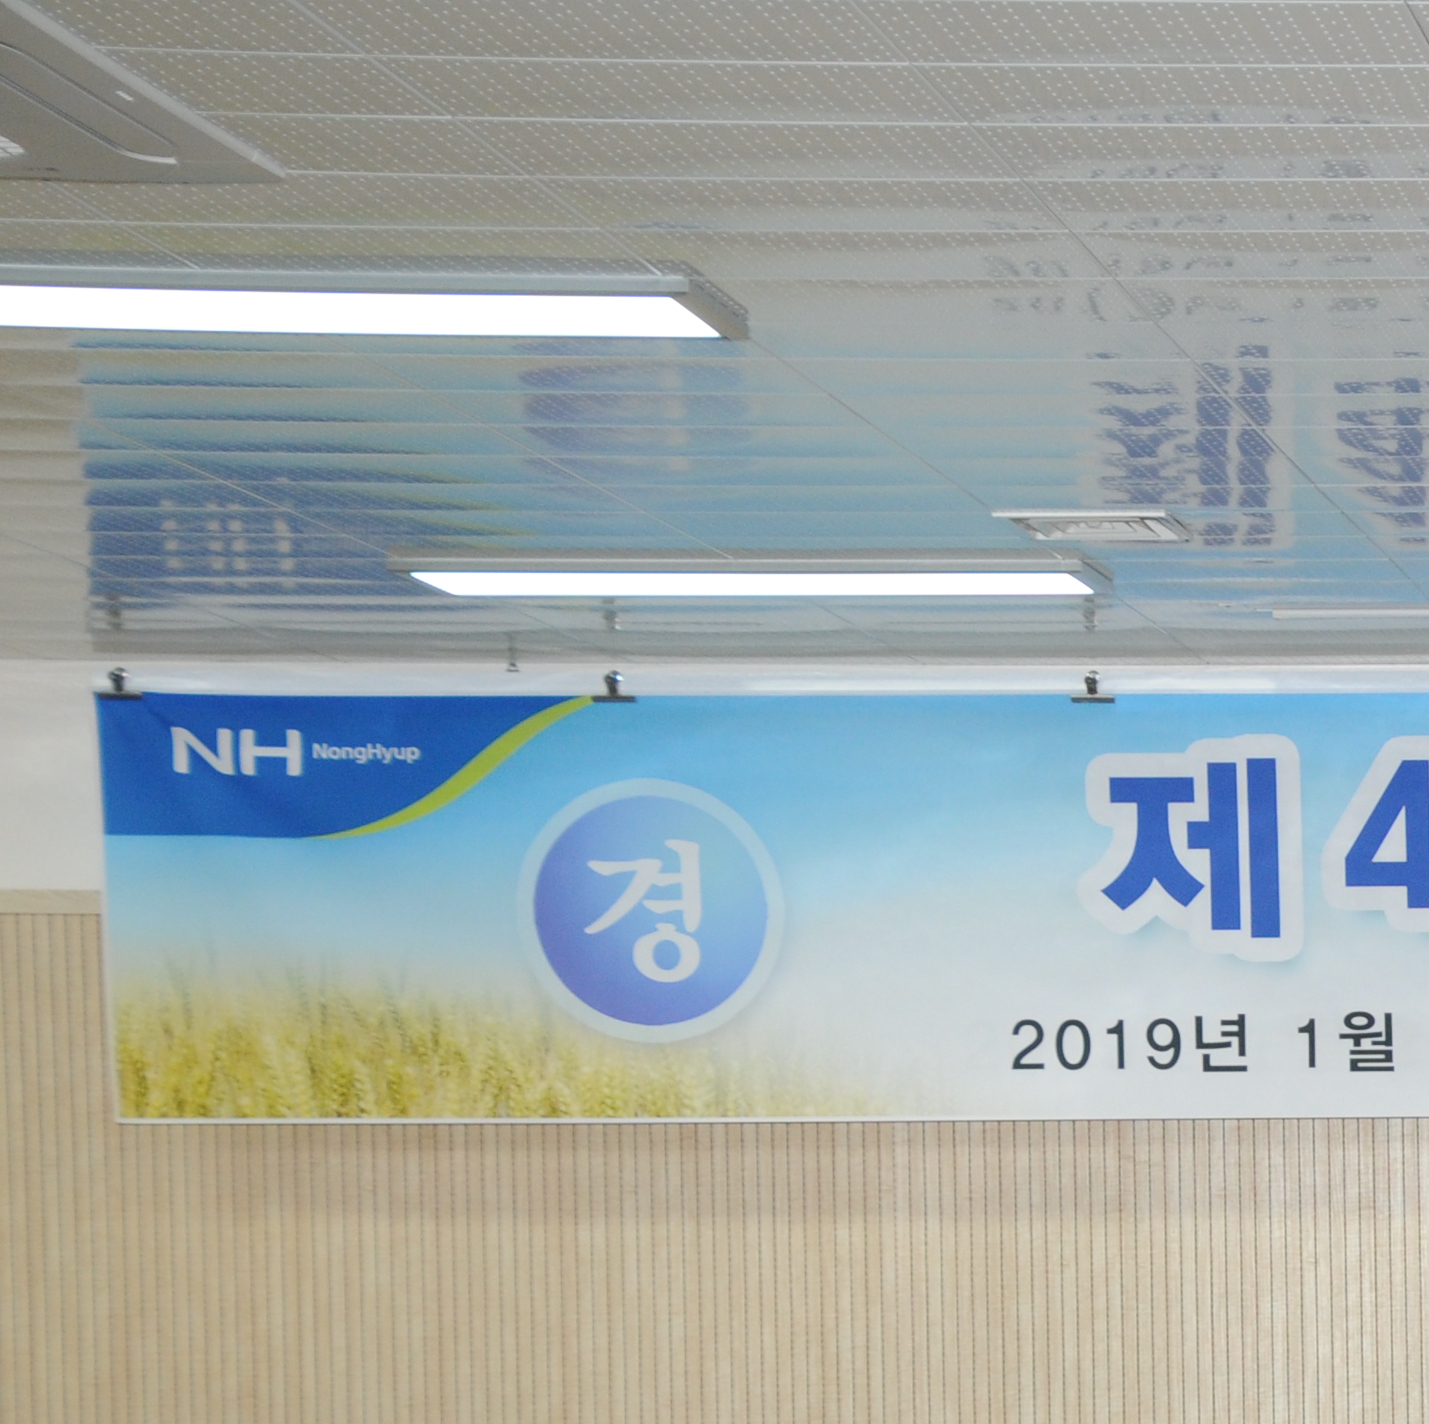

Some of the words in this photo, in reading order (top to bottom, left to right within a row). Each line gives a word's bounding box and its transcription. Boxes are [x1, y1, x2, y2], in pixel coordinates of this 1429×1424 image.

[171, 726, 303, 777] NH
[312, 742, 421, 764] NongHyup
[585, 839, 702, 983] 경
[1011, 1013, 1249, 1073] 2019년
[1298, 1010, 1396, 1073] 1월
